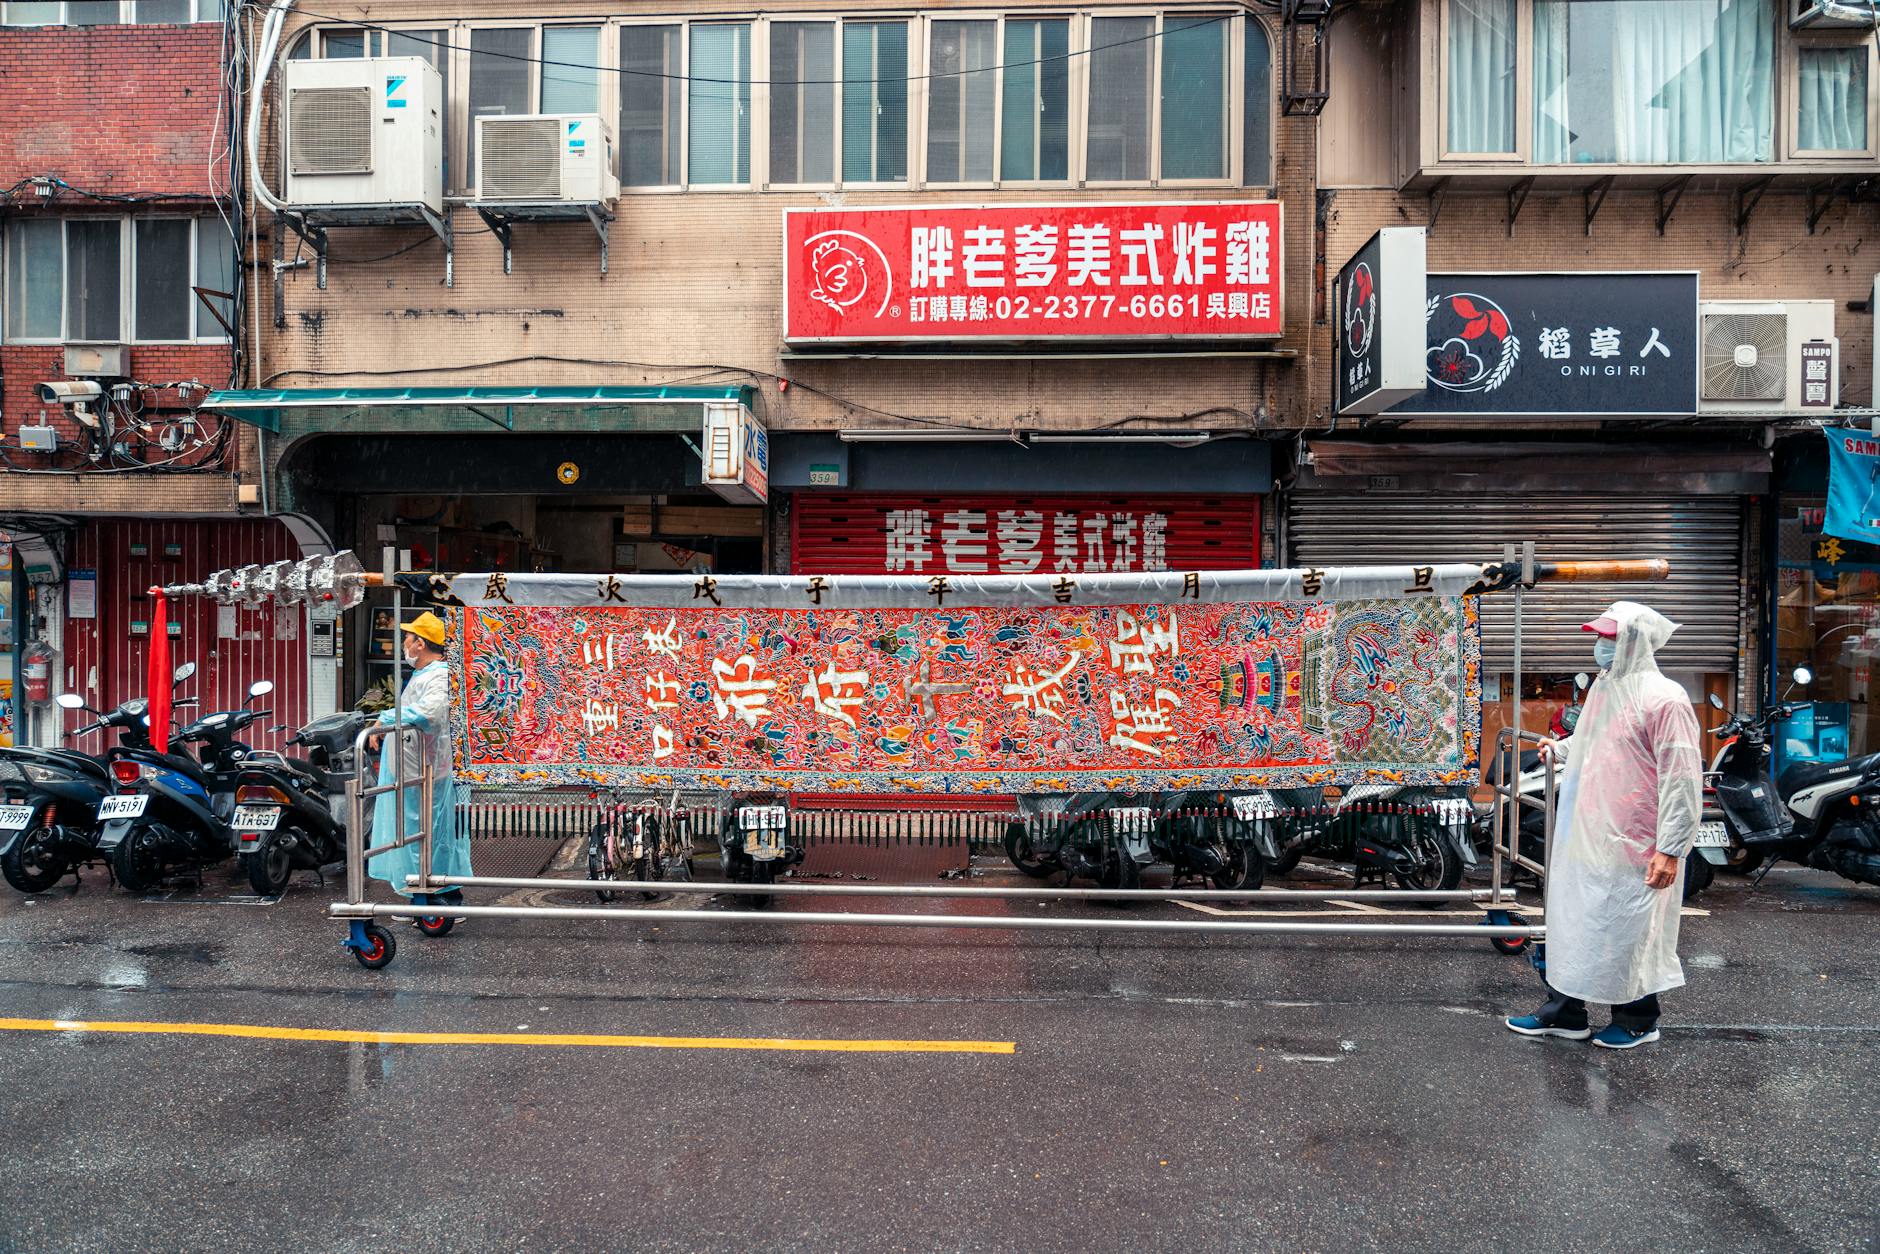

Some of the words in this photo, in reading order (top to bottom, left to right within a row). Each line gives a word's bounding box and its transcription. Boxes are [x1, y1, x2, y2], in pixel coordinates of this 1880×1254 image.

[910, 222, 1271, 288] 胖老爹美式炸雞
[1539, 326, 1671, 358] 稻草人
[1802, 347, 1831, 357] SAMPO
[1844, 437, 1880, 457] SAM
[884, 509, 1168, 573] 胖老爹美式炸雞
[0, 811, 30, 824] T-9999
